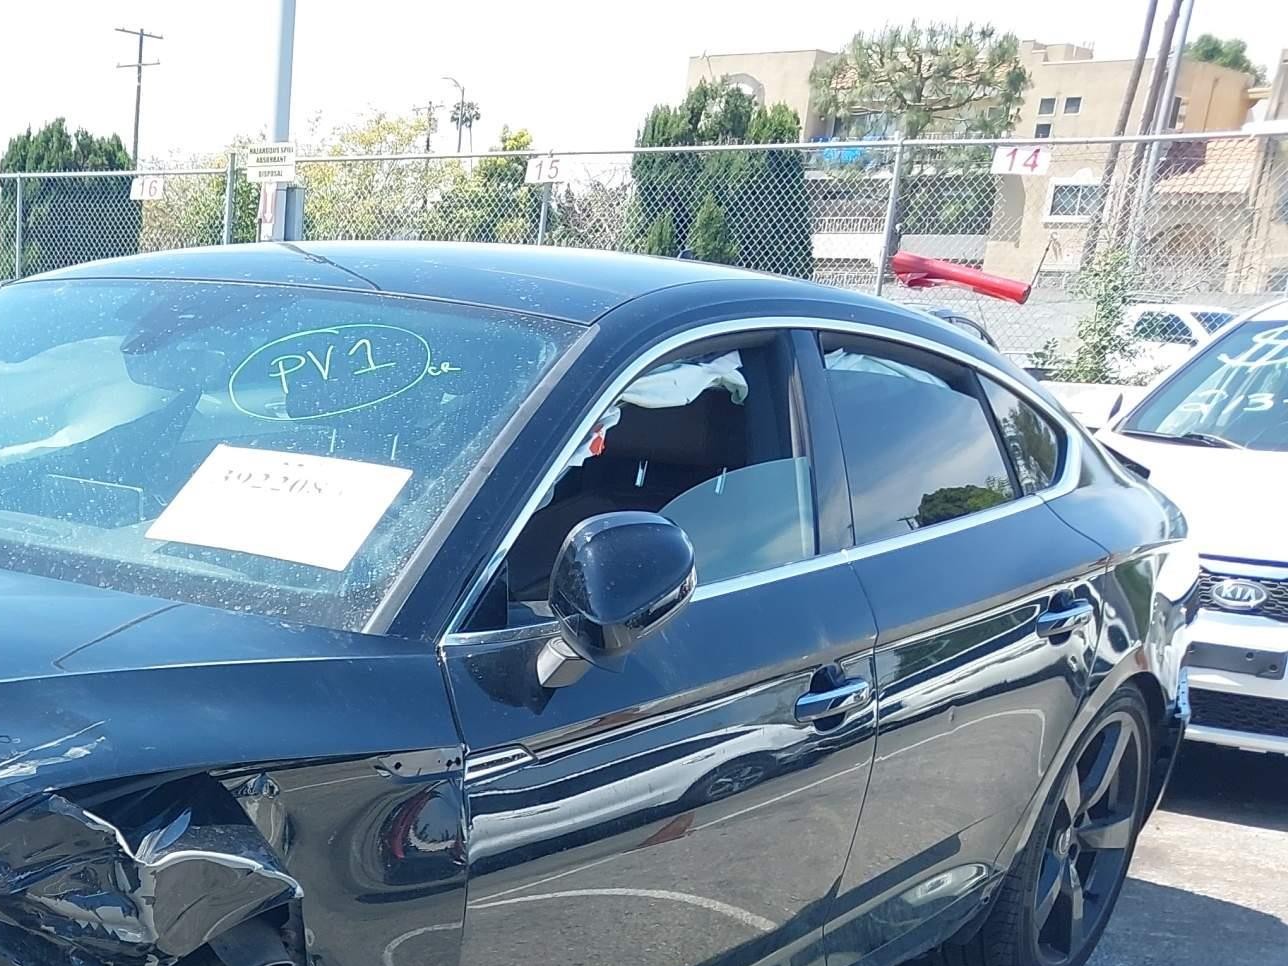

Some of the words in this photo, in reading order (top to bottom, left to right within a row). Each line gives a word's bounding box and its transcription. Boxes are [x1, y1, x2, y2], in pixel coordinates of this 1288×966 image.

[535, 159, 560, 180] 15
[1006, 148, 1040, 172] 14
[139, 178, 158, 197] 16
[1221, 582, 1257, 600] KIA
